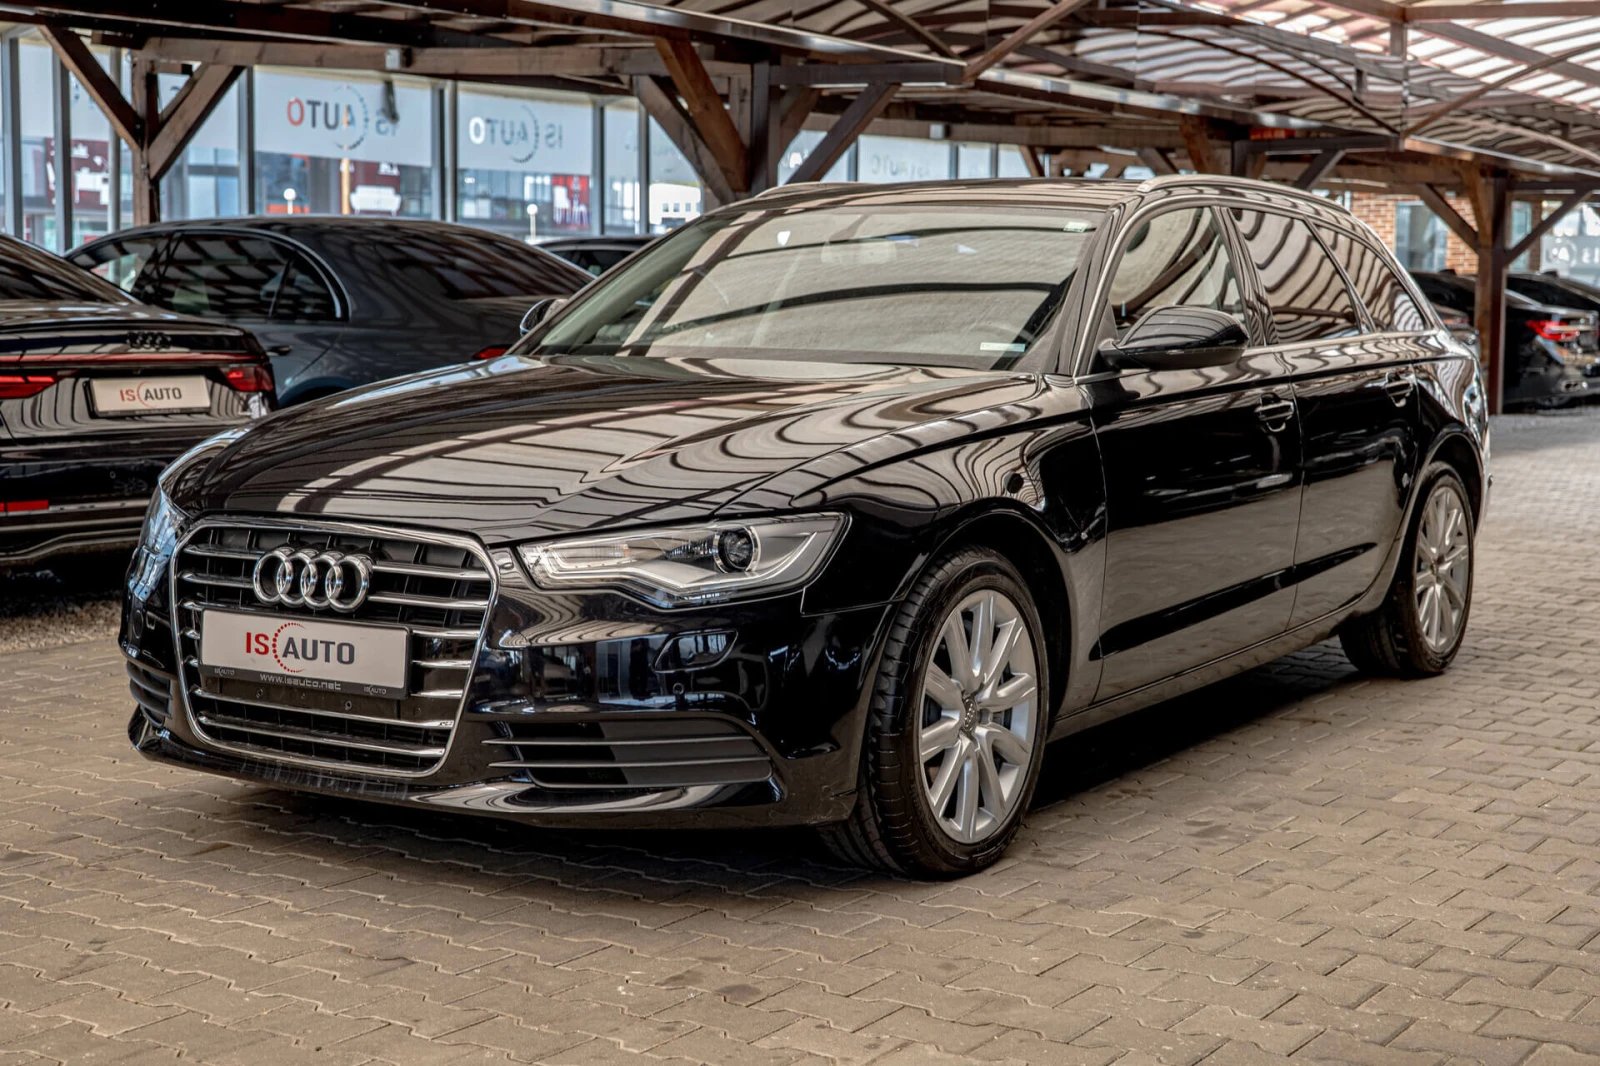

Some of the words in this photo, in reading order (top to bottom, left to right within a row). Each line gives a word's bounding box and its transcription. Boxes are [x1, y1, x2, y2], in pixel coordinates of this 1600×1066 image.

[119, 388, 136, 402] IS
[144, 387, 182, 401] AUTO
[246, 632, 269, 656] IS
[282, 637, 355, 665] AUTO
[260, 673, 342, 691] www.isauto.net
